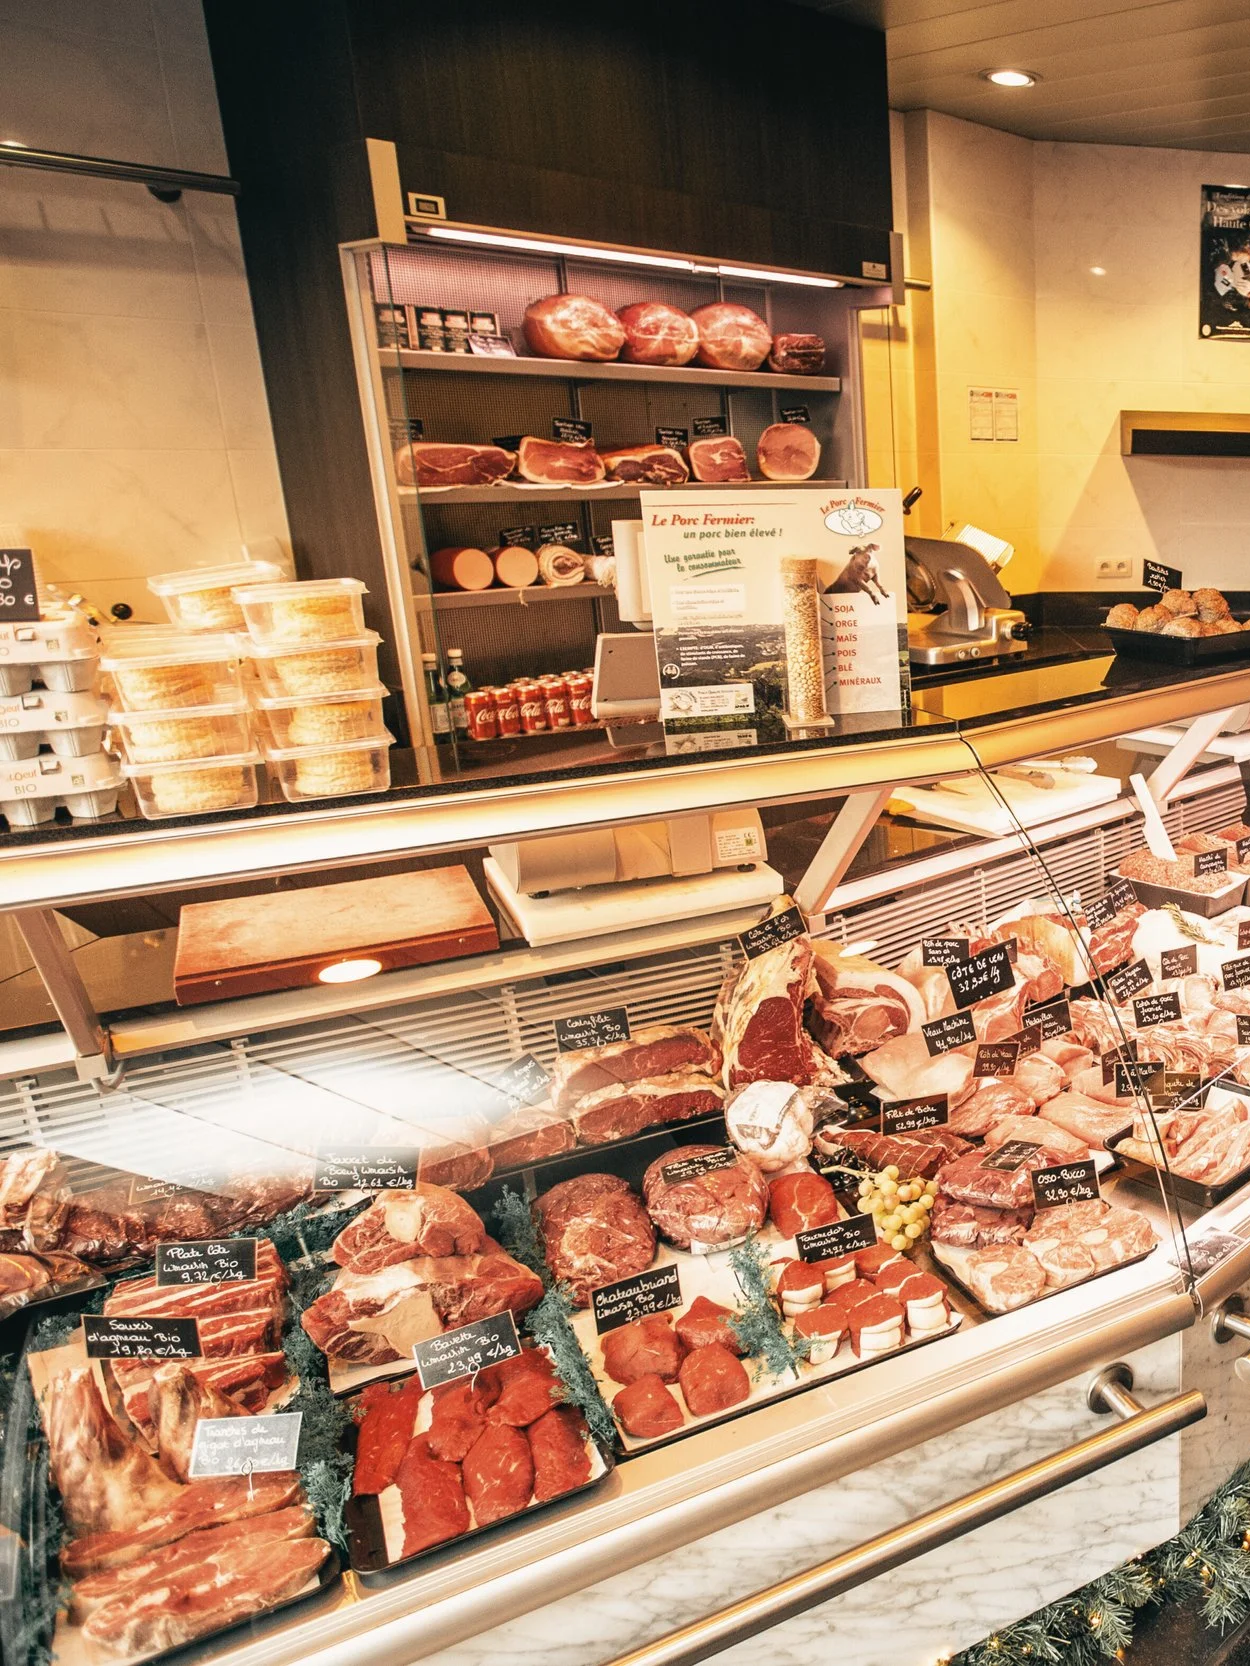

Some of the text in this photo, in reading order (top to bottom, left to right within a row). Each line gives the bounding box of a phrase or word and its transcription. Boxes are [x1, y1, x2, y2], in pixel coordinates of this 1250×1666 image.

[1213, 215, 1247, 229] Haute
[819, 497, 885, 516] Le Porc Fermier
[651, 513, 668, 526] Le
[670, 513, 699, 526] Porc
[683, 531, 695, 539] un
[697, 530, 722, 541] porc
[724, 528, 748, 538] bien
[749, 526, 775, 538] élevé
[663, 548, 736, 565] Une garantie pour
[676, 557, 742, 573] le consommateur
[834, 604, 855, 613] SOJA
[835, 619, 858, 628] ORGE
[836, 634, 858, 643] MAÏS
[837, 649, 857, 658] POIS
[838, 663, 853, 672] BLÉ
[839, 676, 882, 686] MINÉRAUX
[14, 783, 37, 795] BIO
[950, 966, 975, 981] CÔTE
[976, 957, 988, 971] DE
[602, 1024, 620, 1032] Bio
[922, 1026, 943, 1038] Veau
[905, 1106, 915, 1116] de
[376, 1155, 397, 1164] de
[319, 1177, 339, 1187] Bio
[844, 1229, 860, 1239] Bio
[166, 1247, 203, 1260] Plate
[214, 1258, 239, 1269] Bio
[595, 1270, 678, 1306] Chateaubriand
[634, 1292, 655, 1304] Bio
[109, 1320, 153, 1331] Souris
[88, 1332, 181, 1347] d'agneau Bio
[430, 1331, 477, 1351] Bavette
[475, 1334, 500, 1347] Bio
[251, 1424, 268, 1435] de
[233, 1434, 286, 1452] d'agneau
